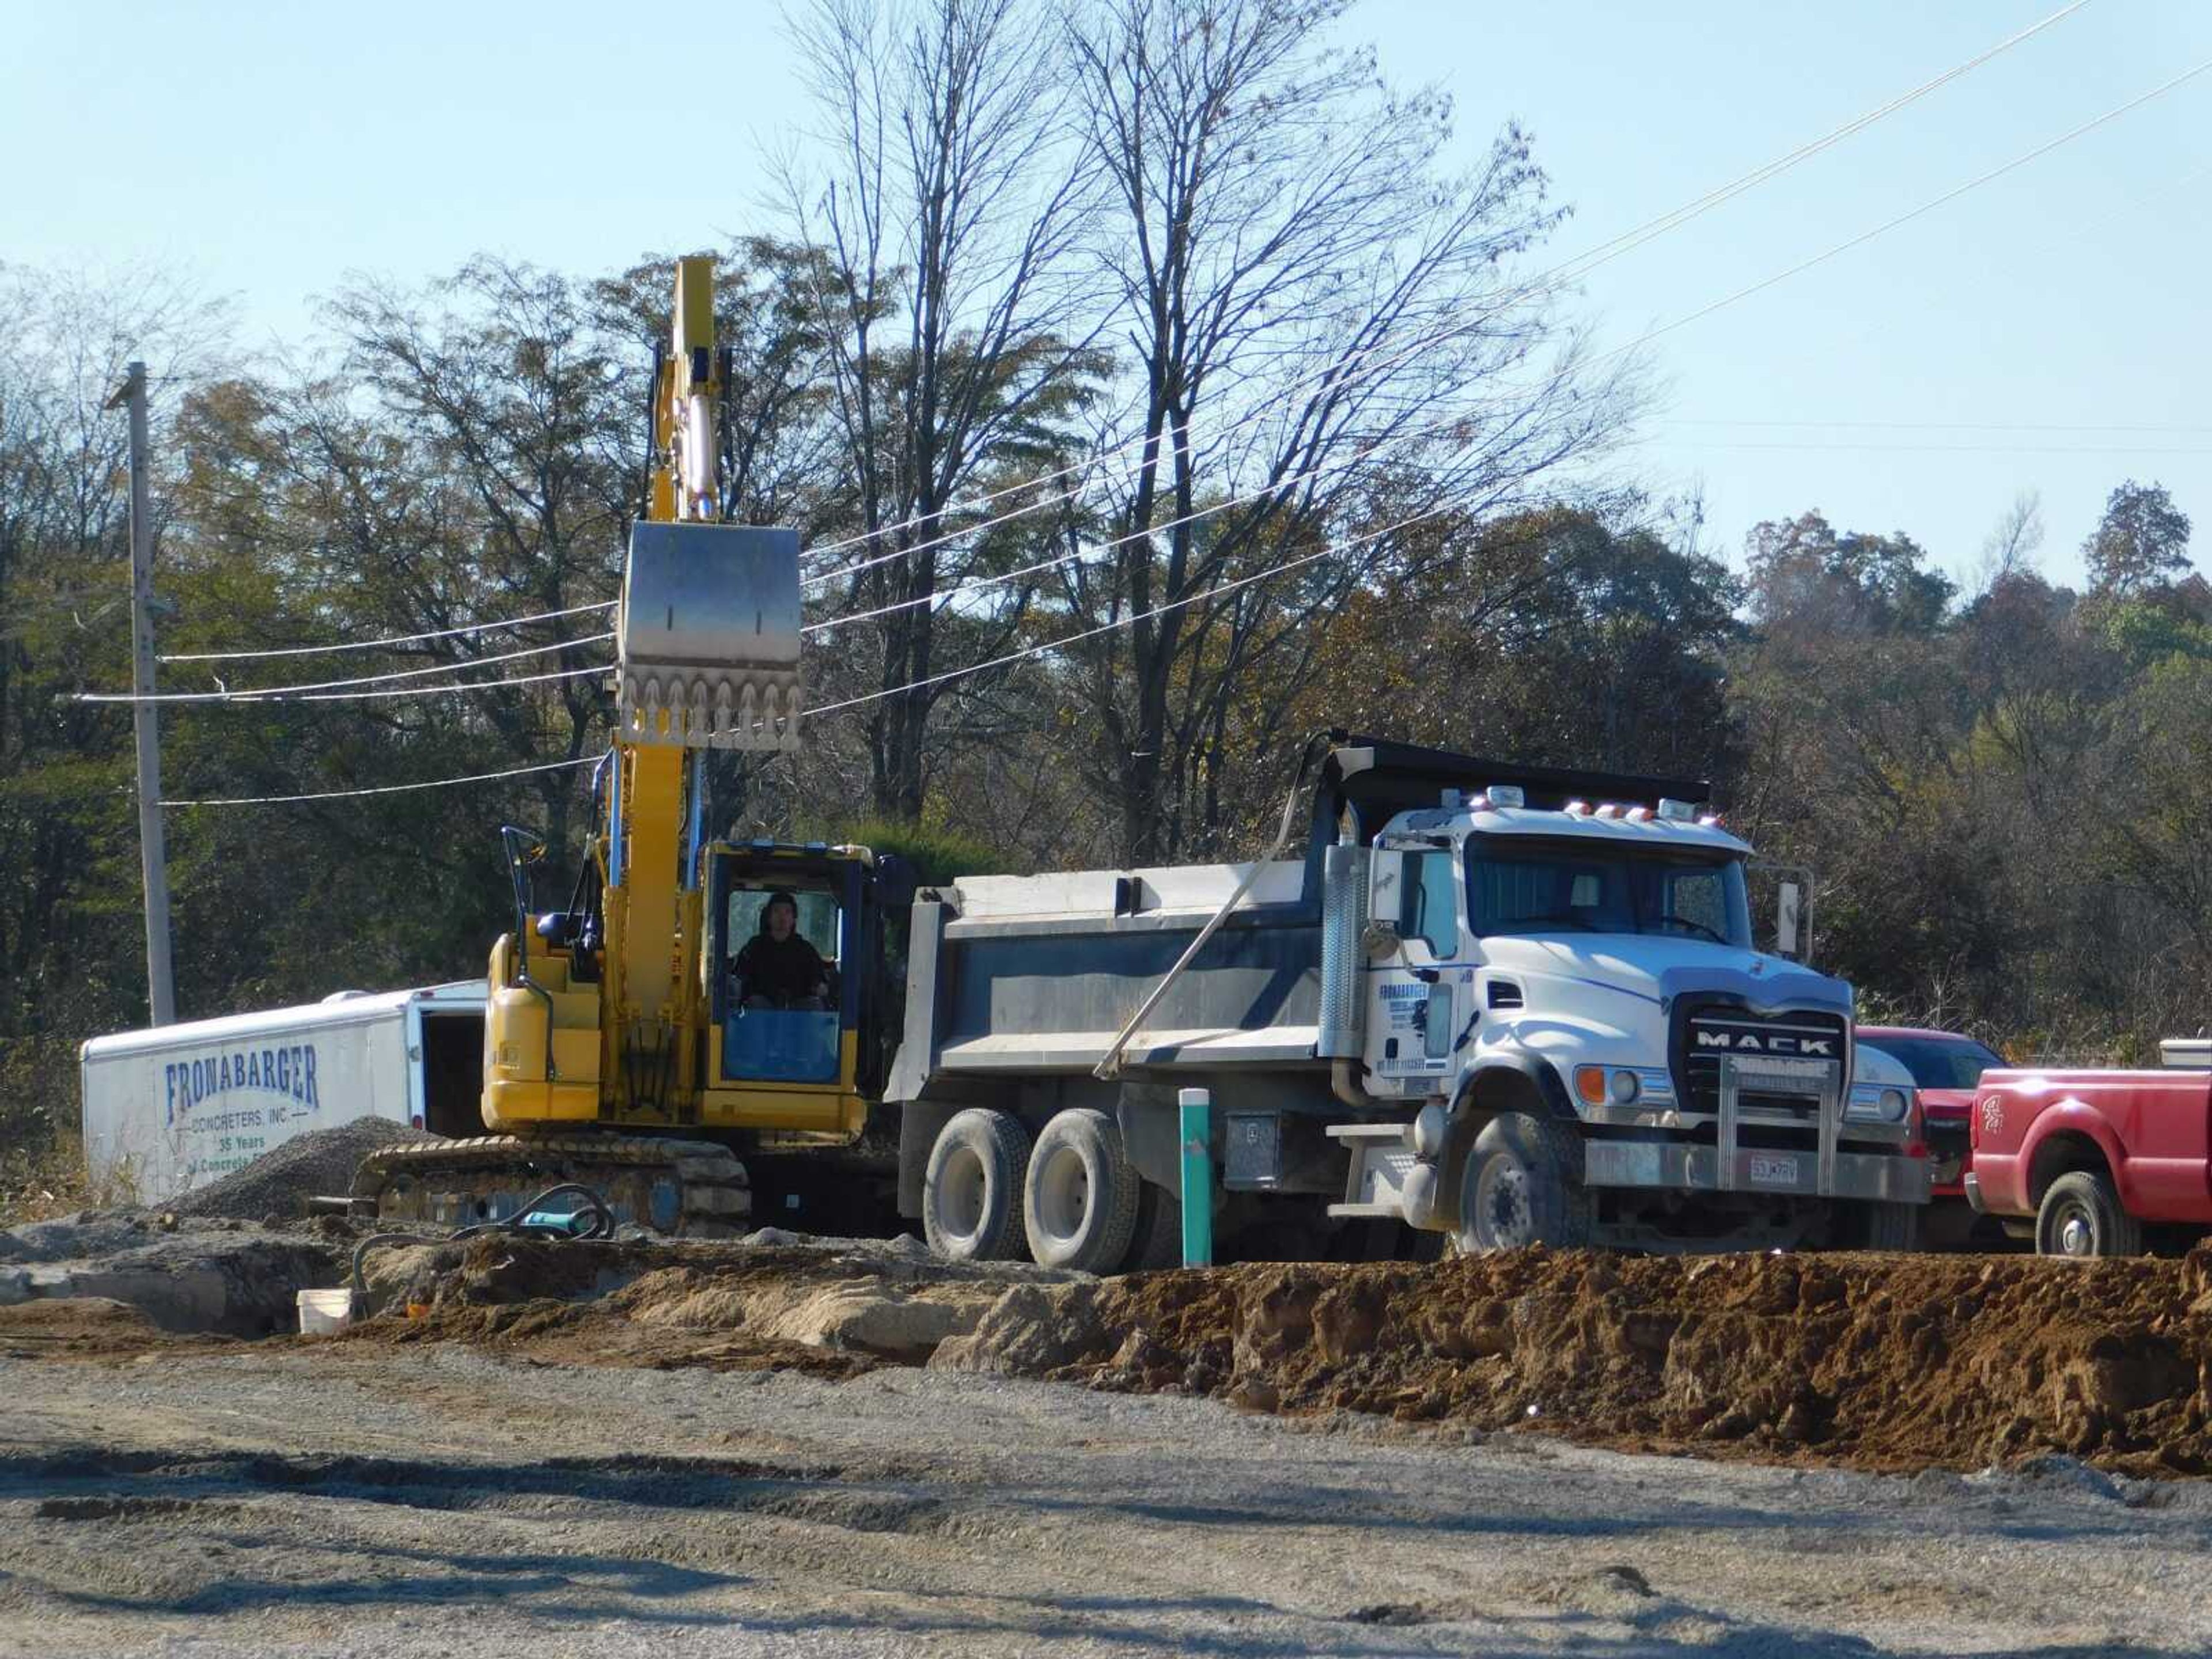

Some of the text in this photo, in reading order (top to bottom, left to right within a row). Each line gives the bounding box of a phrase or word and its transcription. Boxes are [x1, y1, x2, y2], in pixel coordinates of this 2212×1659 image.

[1697, 1031, 1835, 1055] MACK
[165, 1044, 320, 1127] FRONABARGER
[236, 1137, 265, 1149] Years
